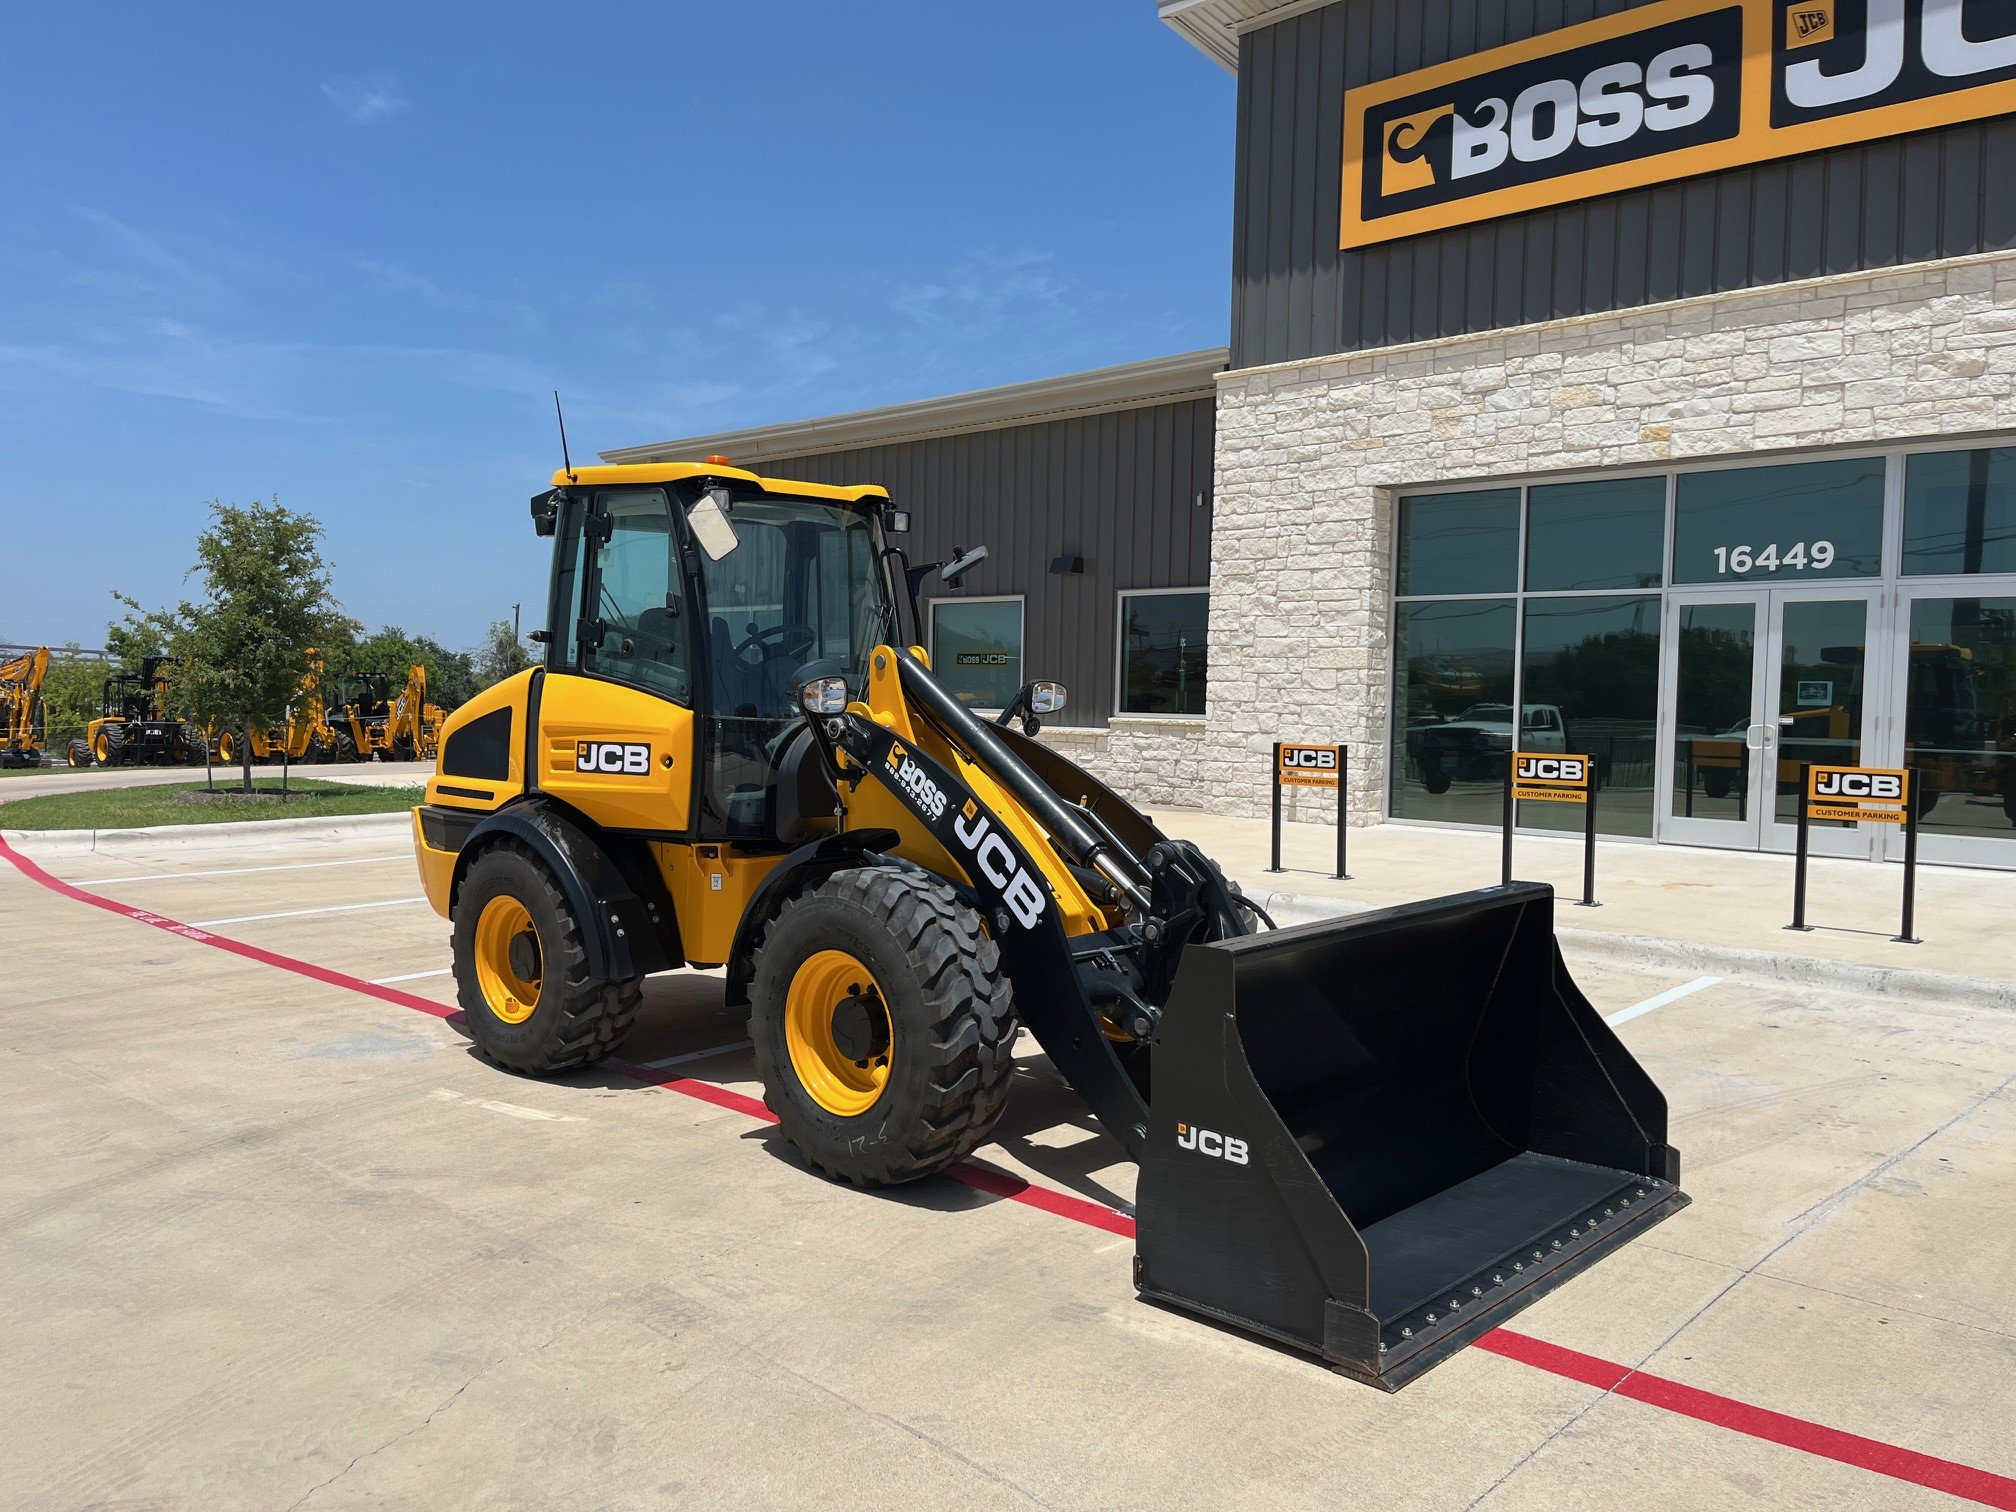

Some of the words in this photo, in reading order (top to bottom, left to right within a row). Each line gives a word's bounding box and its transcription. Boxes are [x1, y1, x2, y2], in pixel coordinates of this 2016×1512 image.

[1799, 13, 1826, 34] JCB
[1451, 43, 1714, 180] BOSS
[1713, 540, 1835, 573] 16449
[578, 744, 648, 773] JCB
[1284, 750, 1335, 768] JCB
[1518, 759, 1582, 780] JCB
[899, 756, 947, 817] BOSS
[1517, 790, 1552, 798] CUSTOMER
[1553, 792, 1582, 800] PARKING
[1817, 773, 1900, 797] JCB
[1815, 809, 1861, 818] CUSTOMER
[1862, 812, 1899, 820] PARKING
[954, 814, 1046, 930] JCB
[1178, 1126, 1249, 1165] JCB
